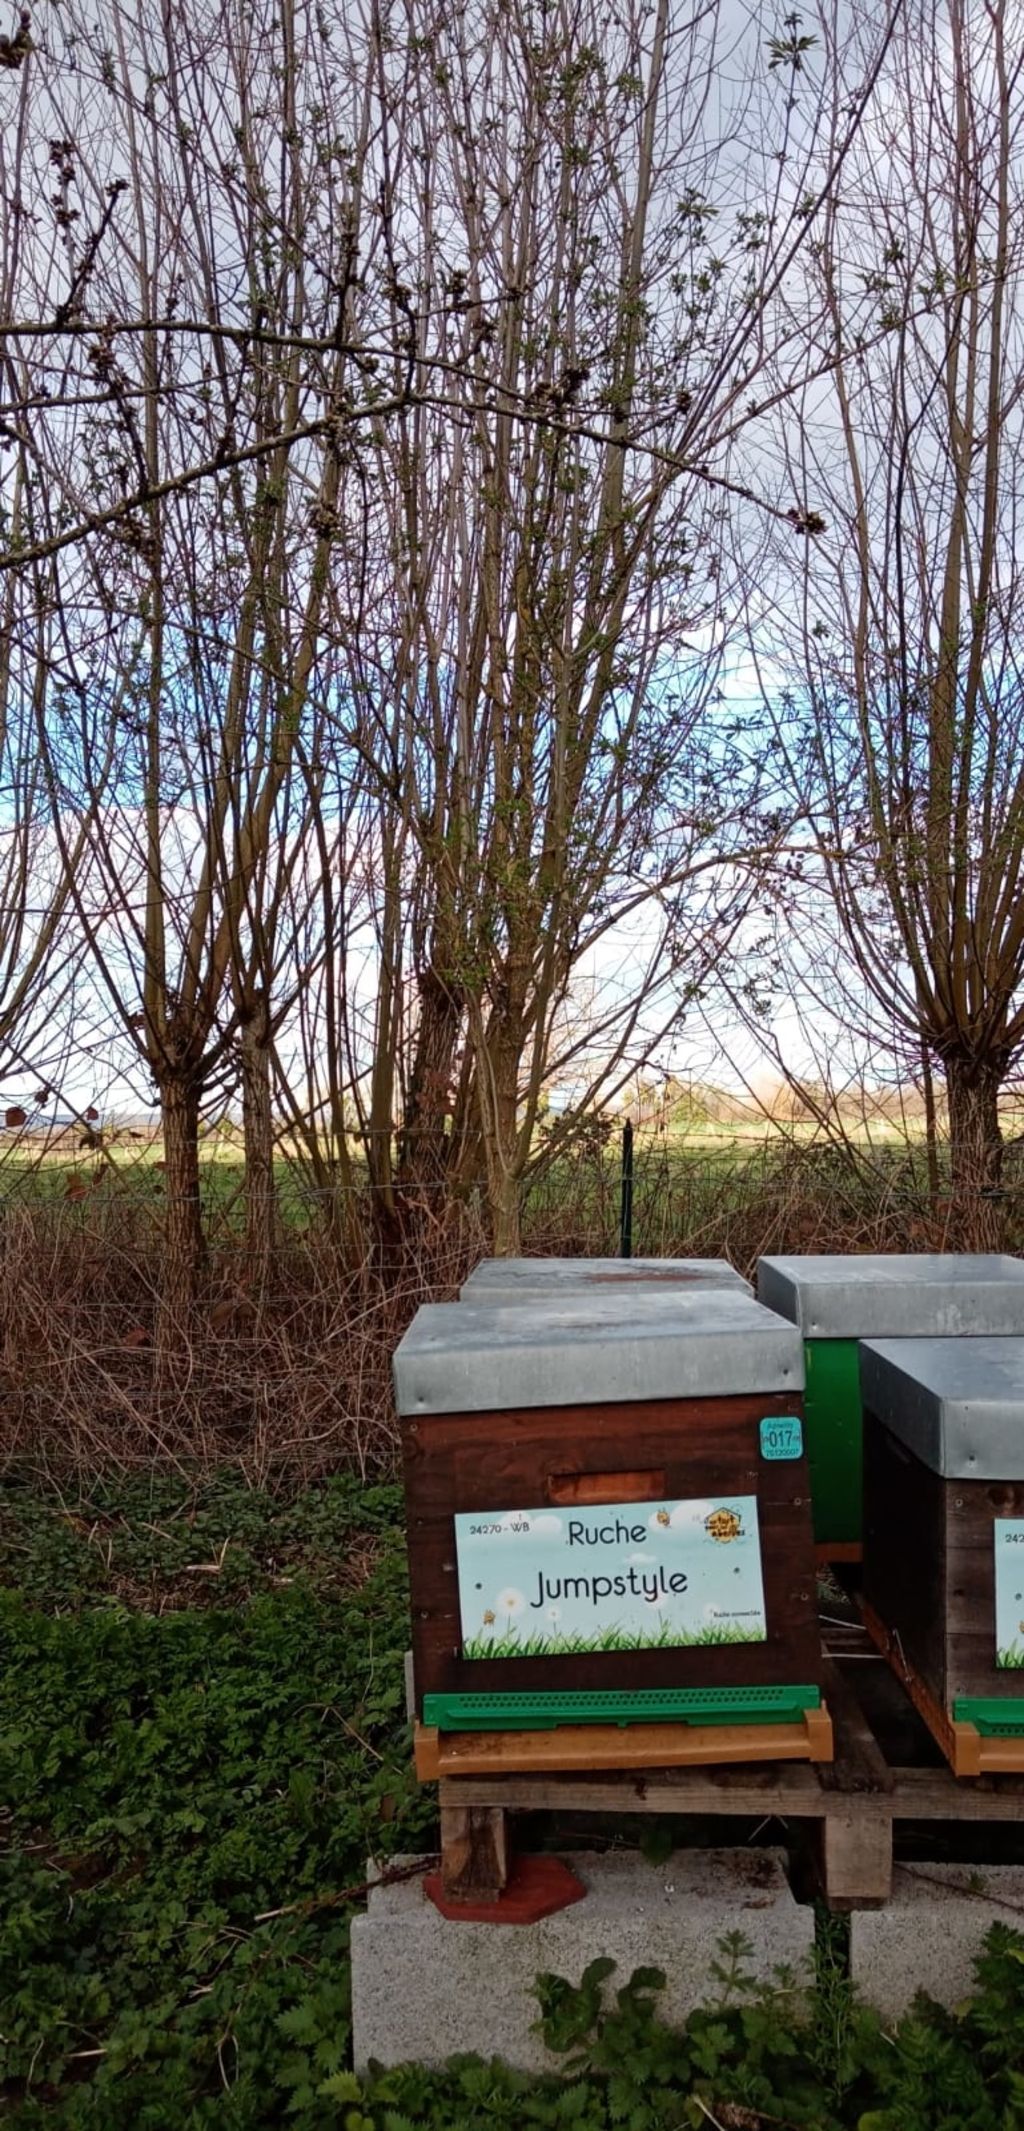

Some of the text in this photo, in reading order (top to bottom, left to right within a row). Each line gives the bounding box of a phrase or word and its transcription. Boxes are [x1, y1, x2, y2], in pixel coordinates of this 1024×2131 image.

[769, 1430, 792, 1448] 017
[470, 1525, 502, 1535] 24270
[512, 1522, 530, 1533] WB
[568, 1520, 647, 1546] Ruche
[530, 1566, 688, 1608] Jumpstyle
